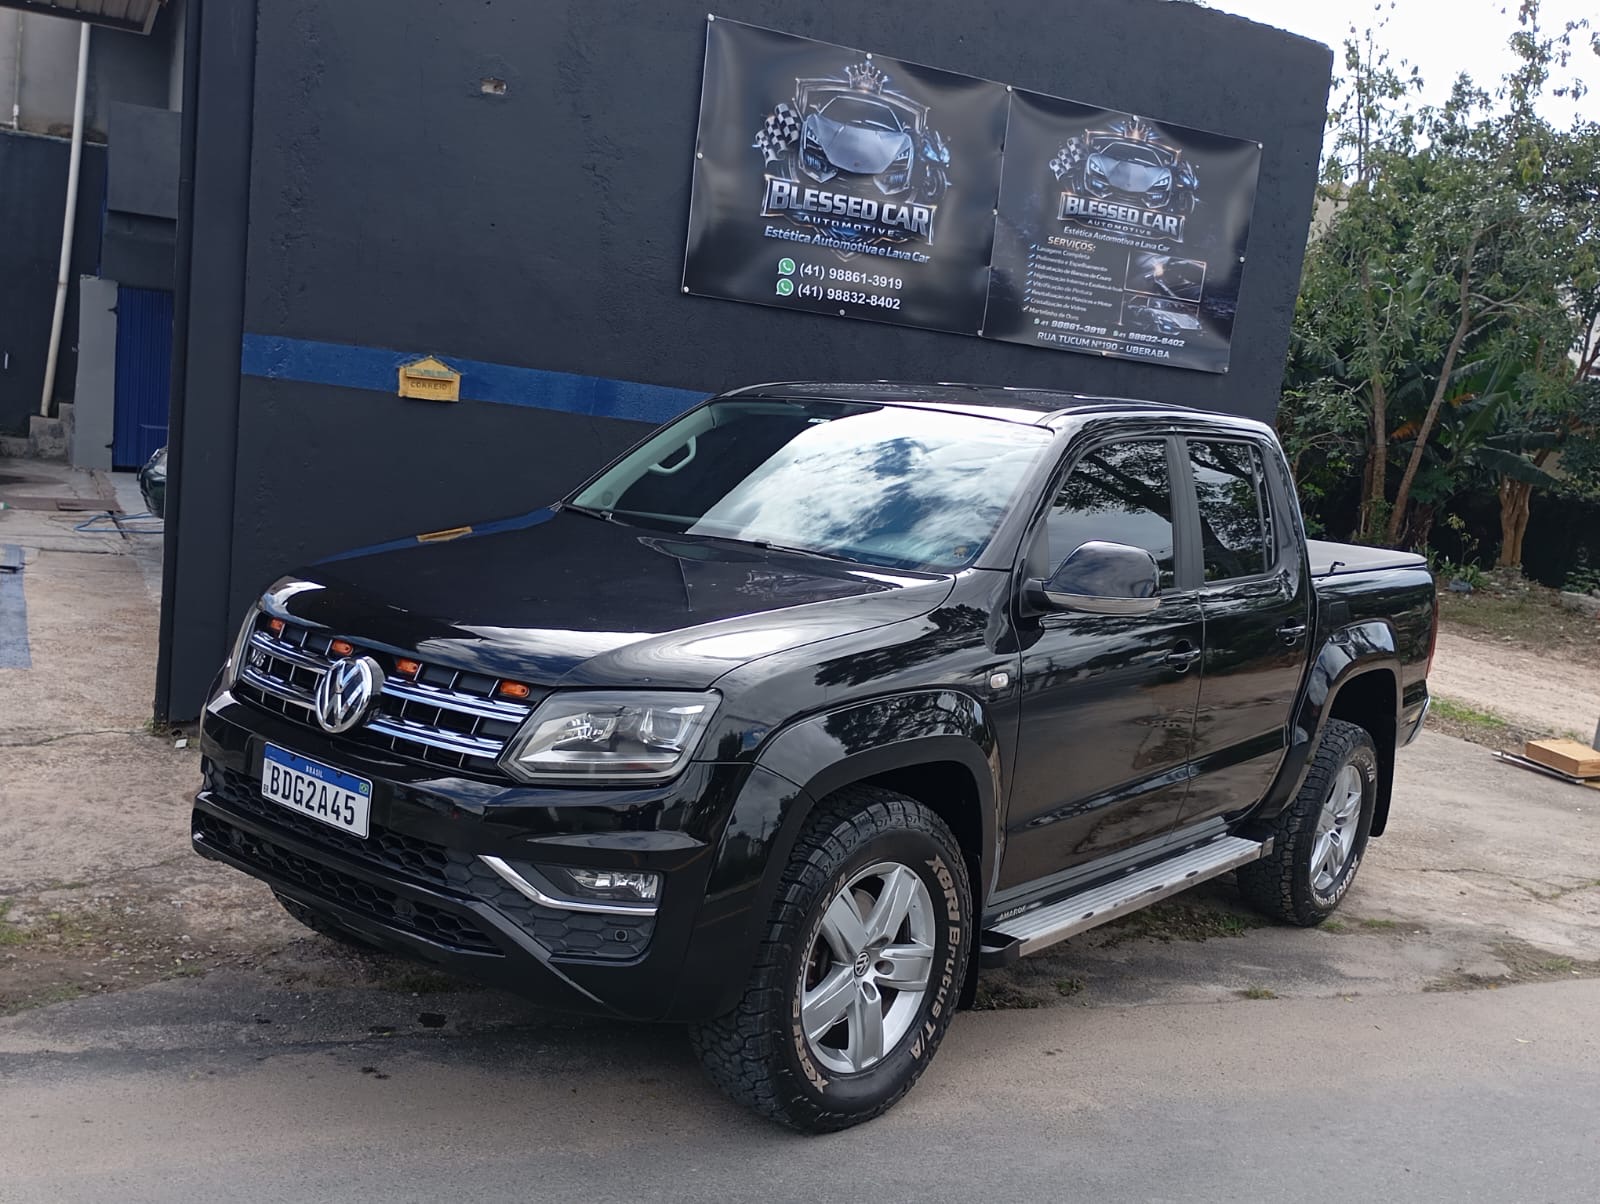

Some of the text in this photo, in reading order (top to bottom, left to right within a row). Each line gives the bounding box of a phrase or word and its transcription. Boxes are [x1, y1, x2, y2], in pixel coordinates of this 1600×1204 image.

[770, 180, 928, 236] BLESSED CAR
[1066, 196, 1178, 236] BLESSED CAR
[803, 215, 894, 236] AUTOMOTIVE
[1088, 219, 1152, 235] AUTOMOTIVE
[765, 226, 931, 263] Estética Automotiva e Lava Car
[1048, 236, 1096, 252] SERVIÇOS:
[1064, 226, 1094, 239] Estética
[1094, 232, 1134, 247] Automotiva
[1140, 240, 1157, 250] Lava
[1158, 243, 1170, 252] Car
[800, 263, 902, 290] (41) 98861-3919
[798, 284, 900, 310] (41) 98832-8402
[1037, 332, 1056, 342] RUA
[1058, 334, 1090, 346] TUCUM
[1126, 345, 1170, 359] UBERABA
[410, 381, 448, 390] CORREIO
[306, 764, 323, 778] BRASIL
[270, 765, 356, 826] BDG2A45
[910, 854, 960, 1060] XBRI Brutus T/A
